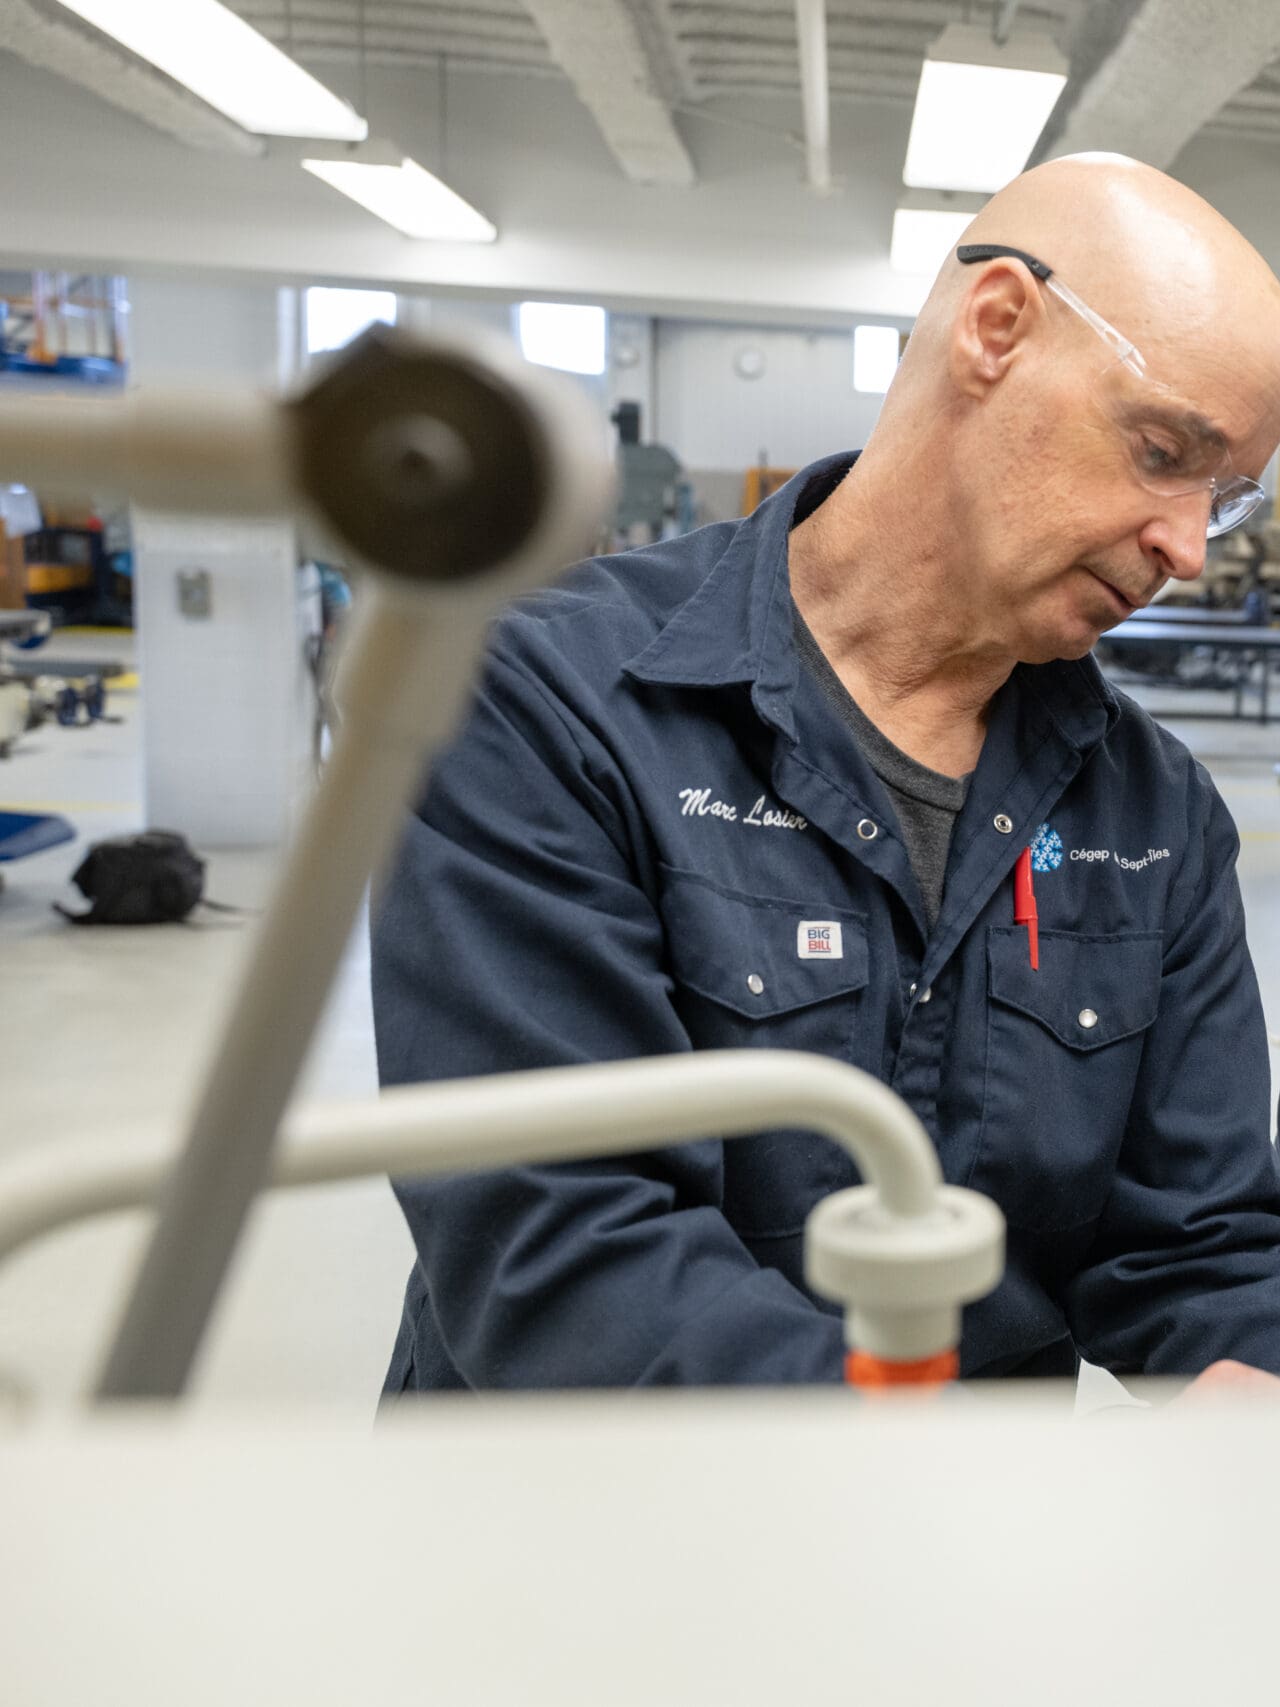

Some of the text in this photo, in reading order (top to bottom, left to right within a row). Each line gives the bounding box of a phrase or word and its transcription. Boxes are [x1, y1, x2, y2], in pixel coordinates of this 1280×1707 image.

[679, 788, 807, 830] Marc Losier
[1069, 848, 1110, 862] Cégep
[807, 929, 831, 940] BIG
[808, 940, 832, 951] BILL
